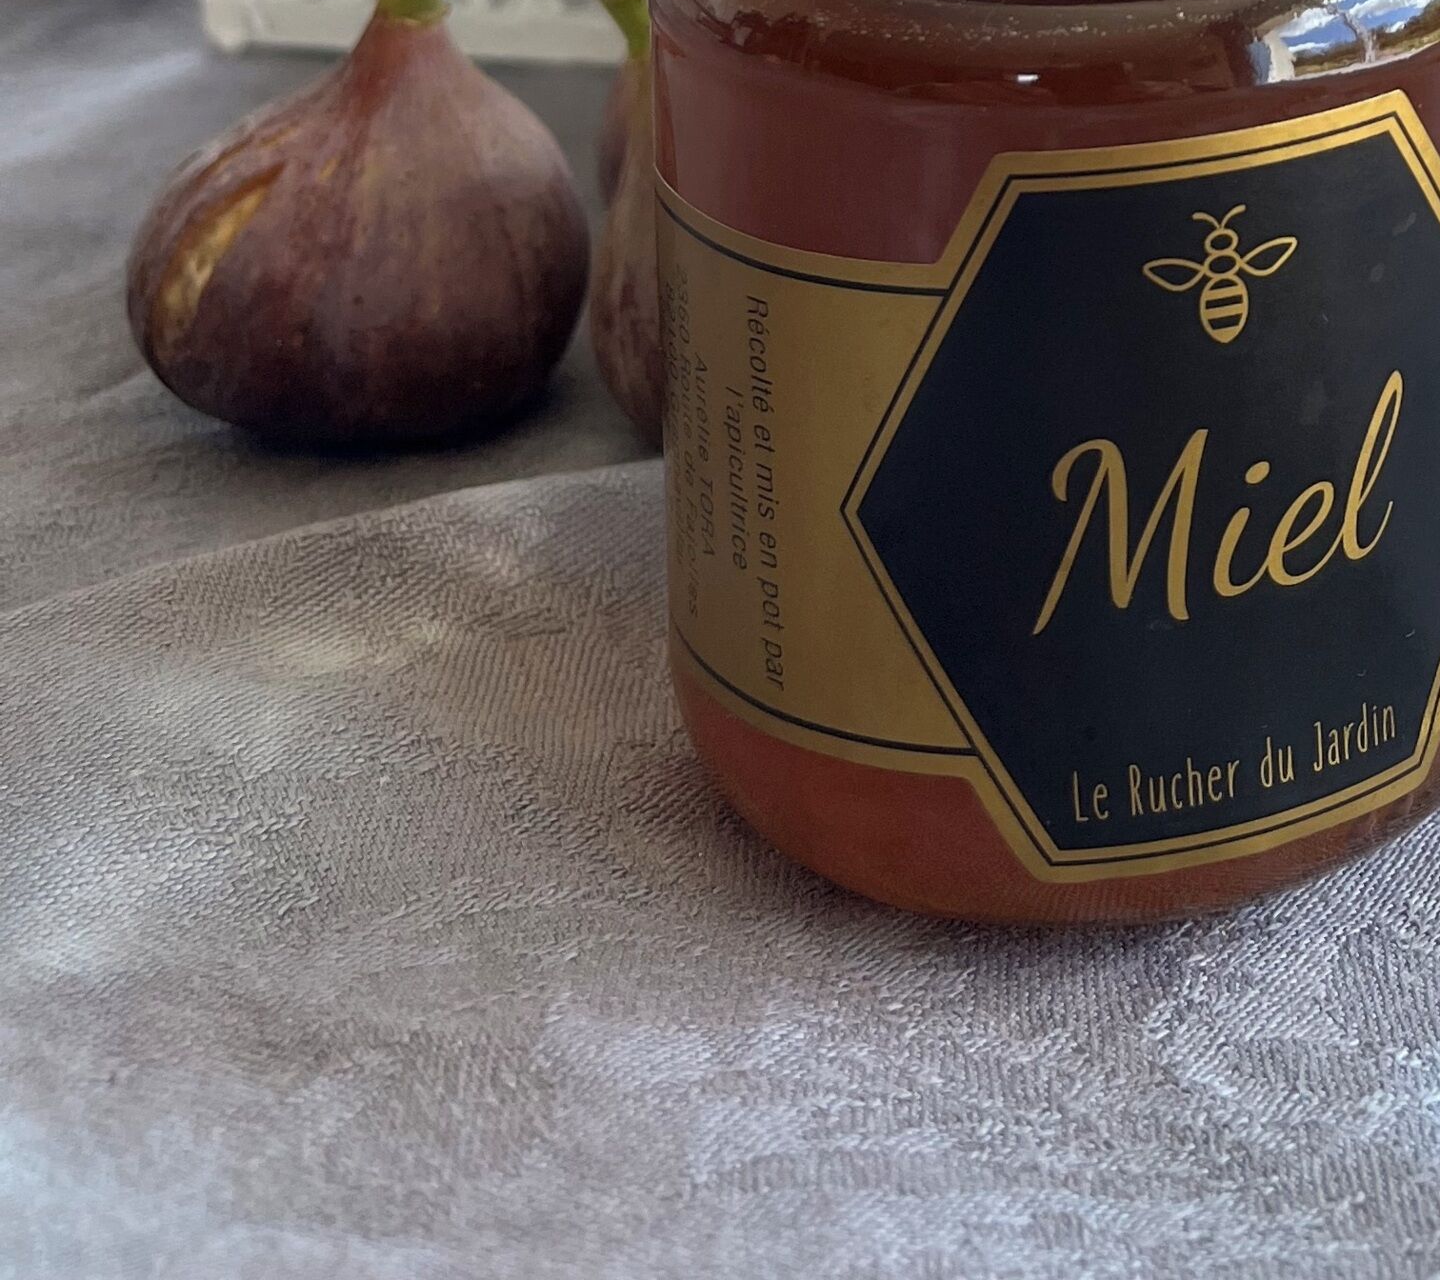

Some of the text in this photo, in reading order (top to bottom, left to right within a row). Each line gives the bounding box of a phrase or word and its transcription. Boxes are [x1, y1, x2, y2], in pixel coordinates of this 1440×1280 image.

[723, 386, 750, 570] l'apicultrice
[747, 295, 785, 691] Récolté et mis en pot par
[1031, 370, 1404, 636] Miel
[1074, 703, 1396, 823] Le Rucher du Jardin
